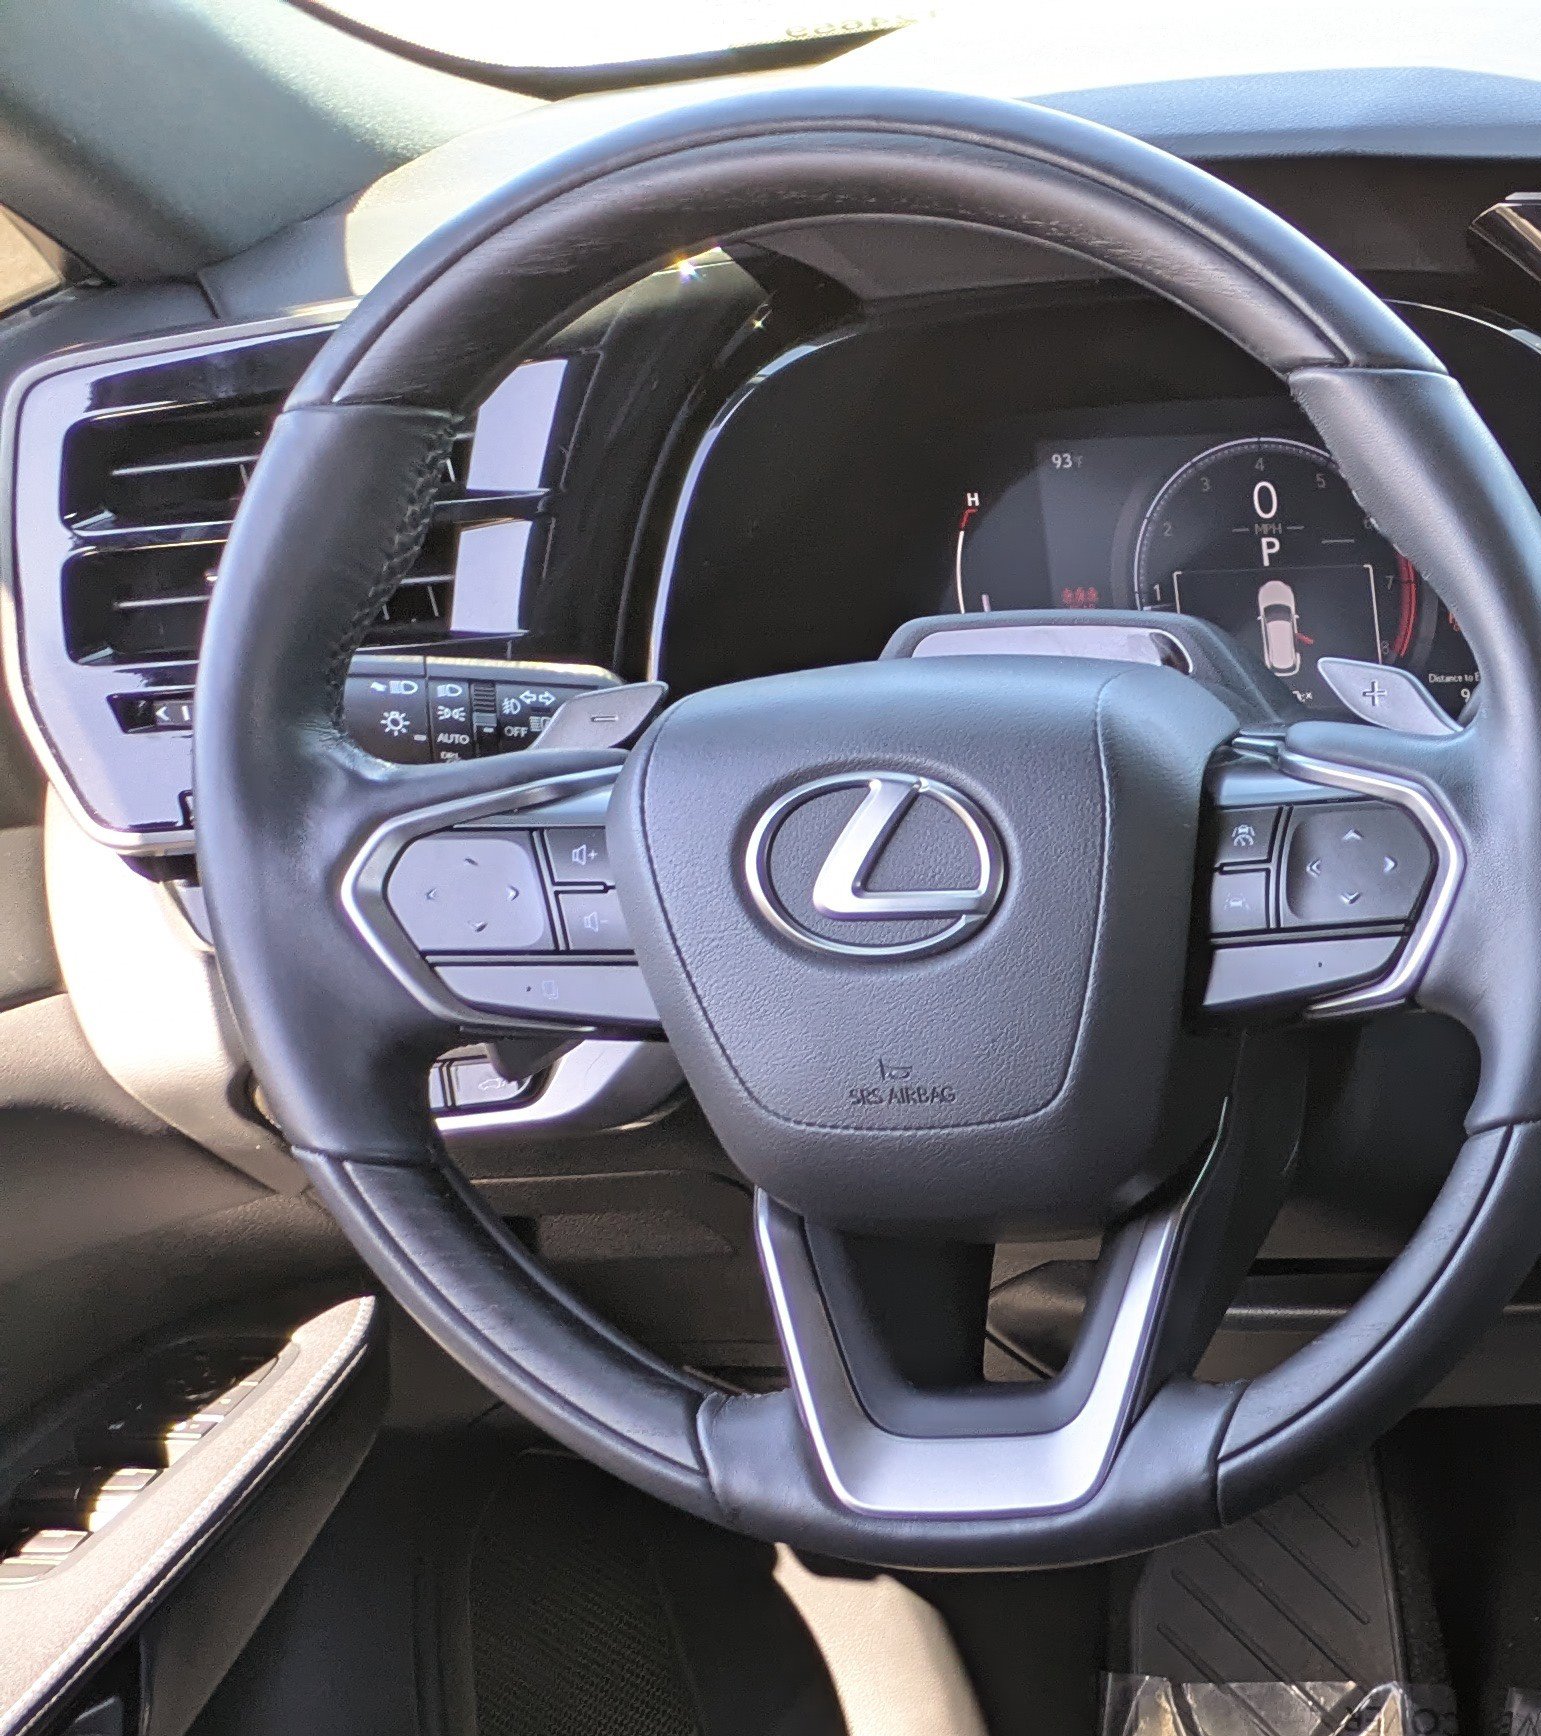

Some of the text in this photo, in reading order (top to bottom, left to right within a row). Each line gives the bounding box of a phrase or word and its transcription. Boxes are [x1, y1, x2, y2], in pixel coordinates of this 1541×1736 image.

[966, 492, 980, 507] H
[1260, 537, 1280, 566] P
[1428, 673, 1462, 683] Distance
[437, 732, 470, 745] AUTO
[504, 725, 529, 738] OFF
[849, 1086, 956, 1105] SRS AIRBAG
